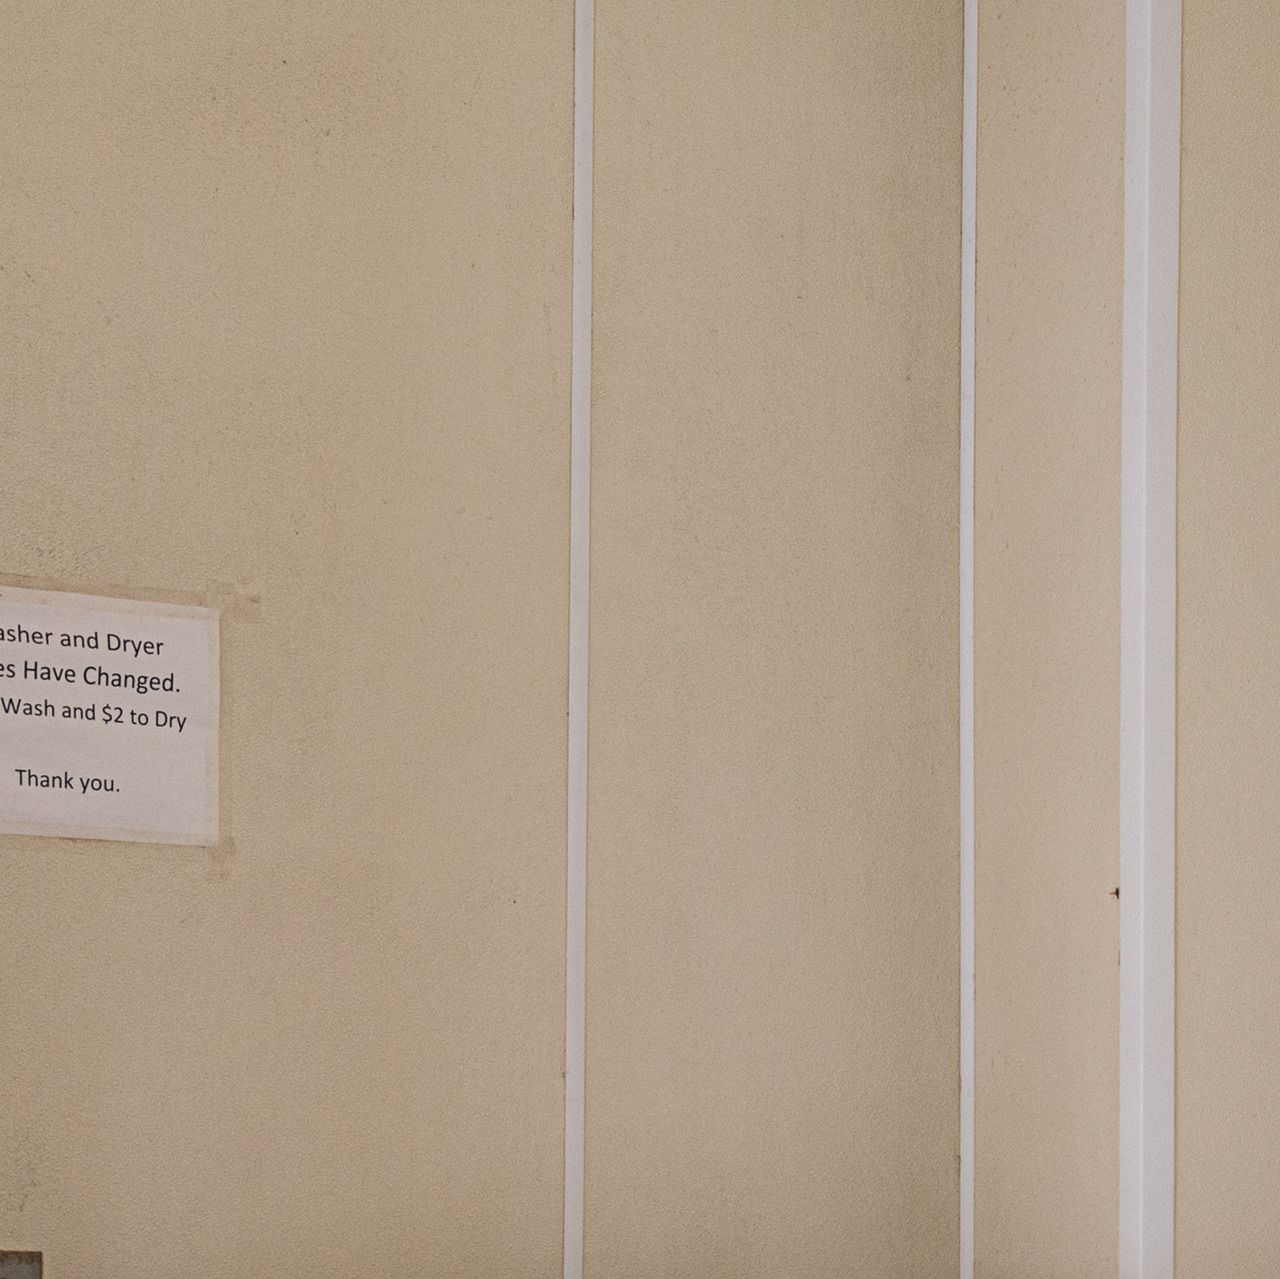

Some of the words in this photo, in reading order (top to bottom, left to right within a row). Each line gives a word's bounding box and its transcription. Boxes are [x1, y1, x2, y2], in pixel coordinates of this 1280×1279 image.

[59, 631, 99, 650] and
[106, 633, 165, 659] Dryer
[23, 660, 76, 684] Have
[82, 665, 181, 695] Changed.
[0, 696, 55, 718] Wash
[61, 703, 96, 721] and
[101, 703, 124, 725] $2
[129, 709, 149, 726] to
[155, 710, 187, 733] Dry
[14, 768, 74, 790] Thank
[79, 777, 120, 795] you.
